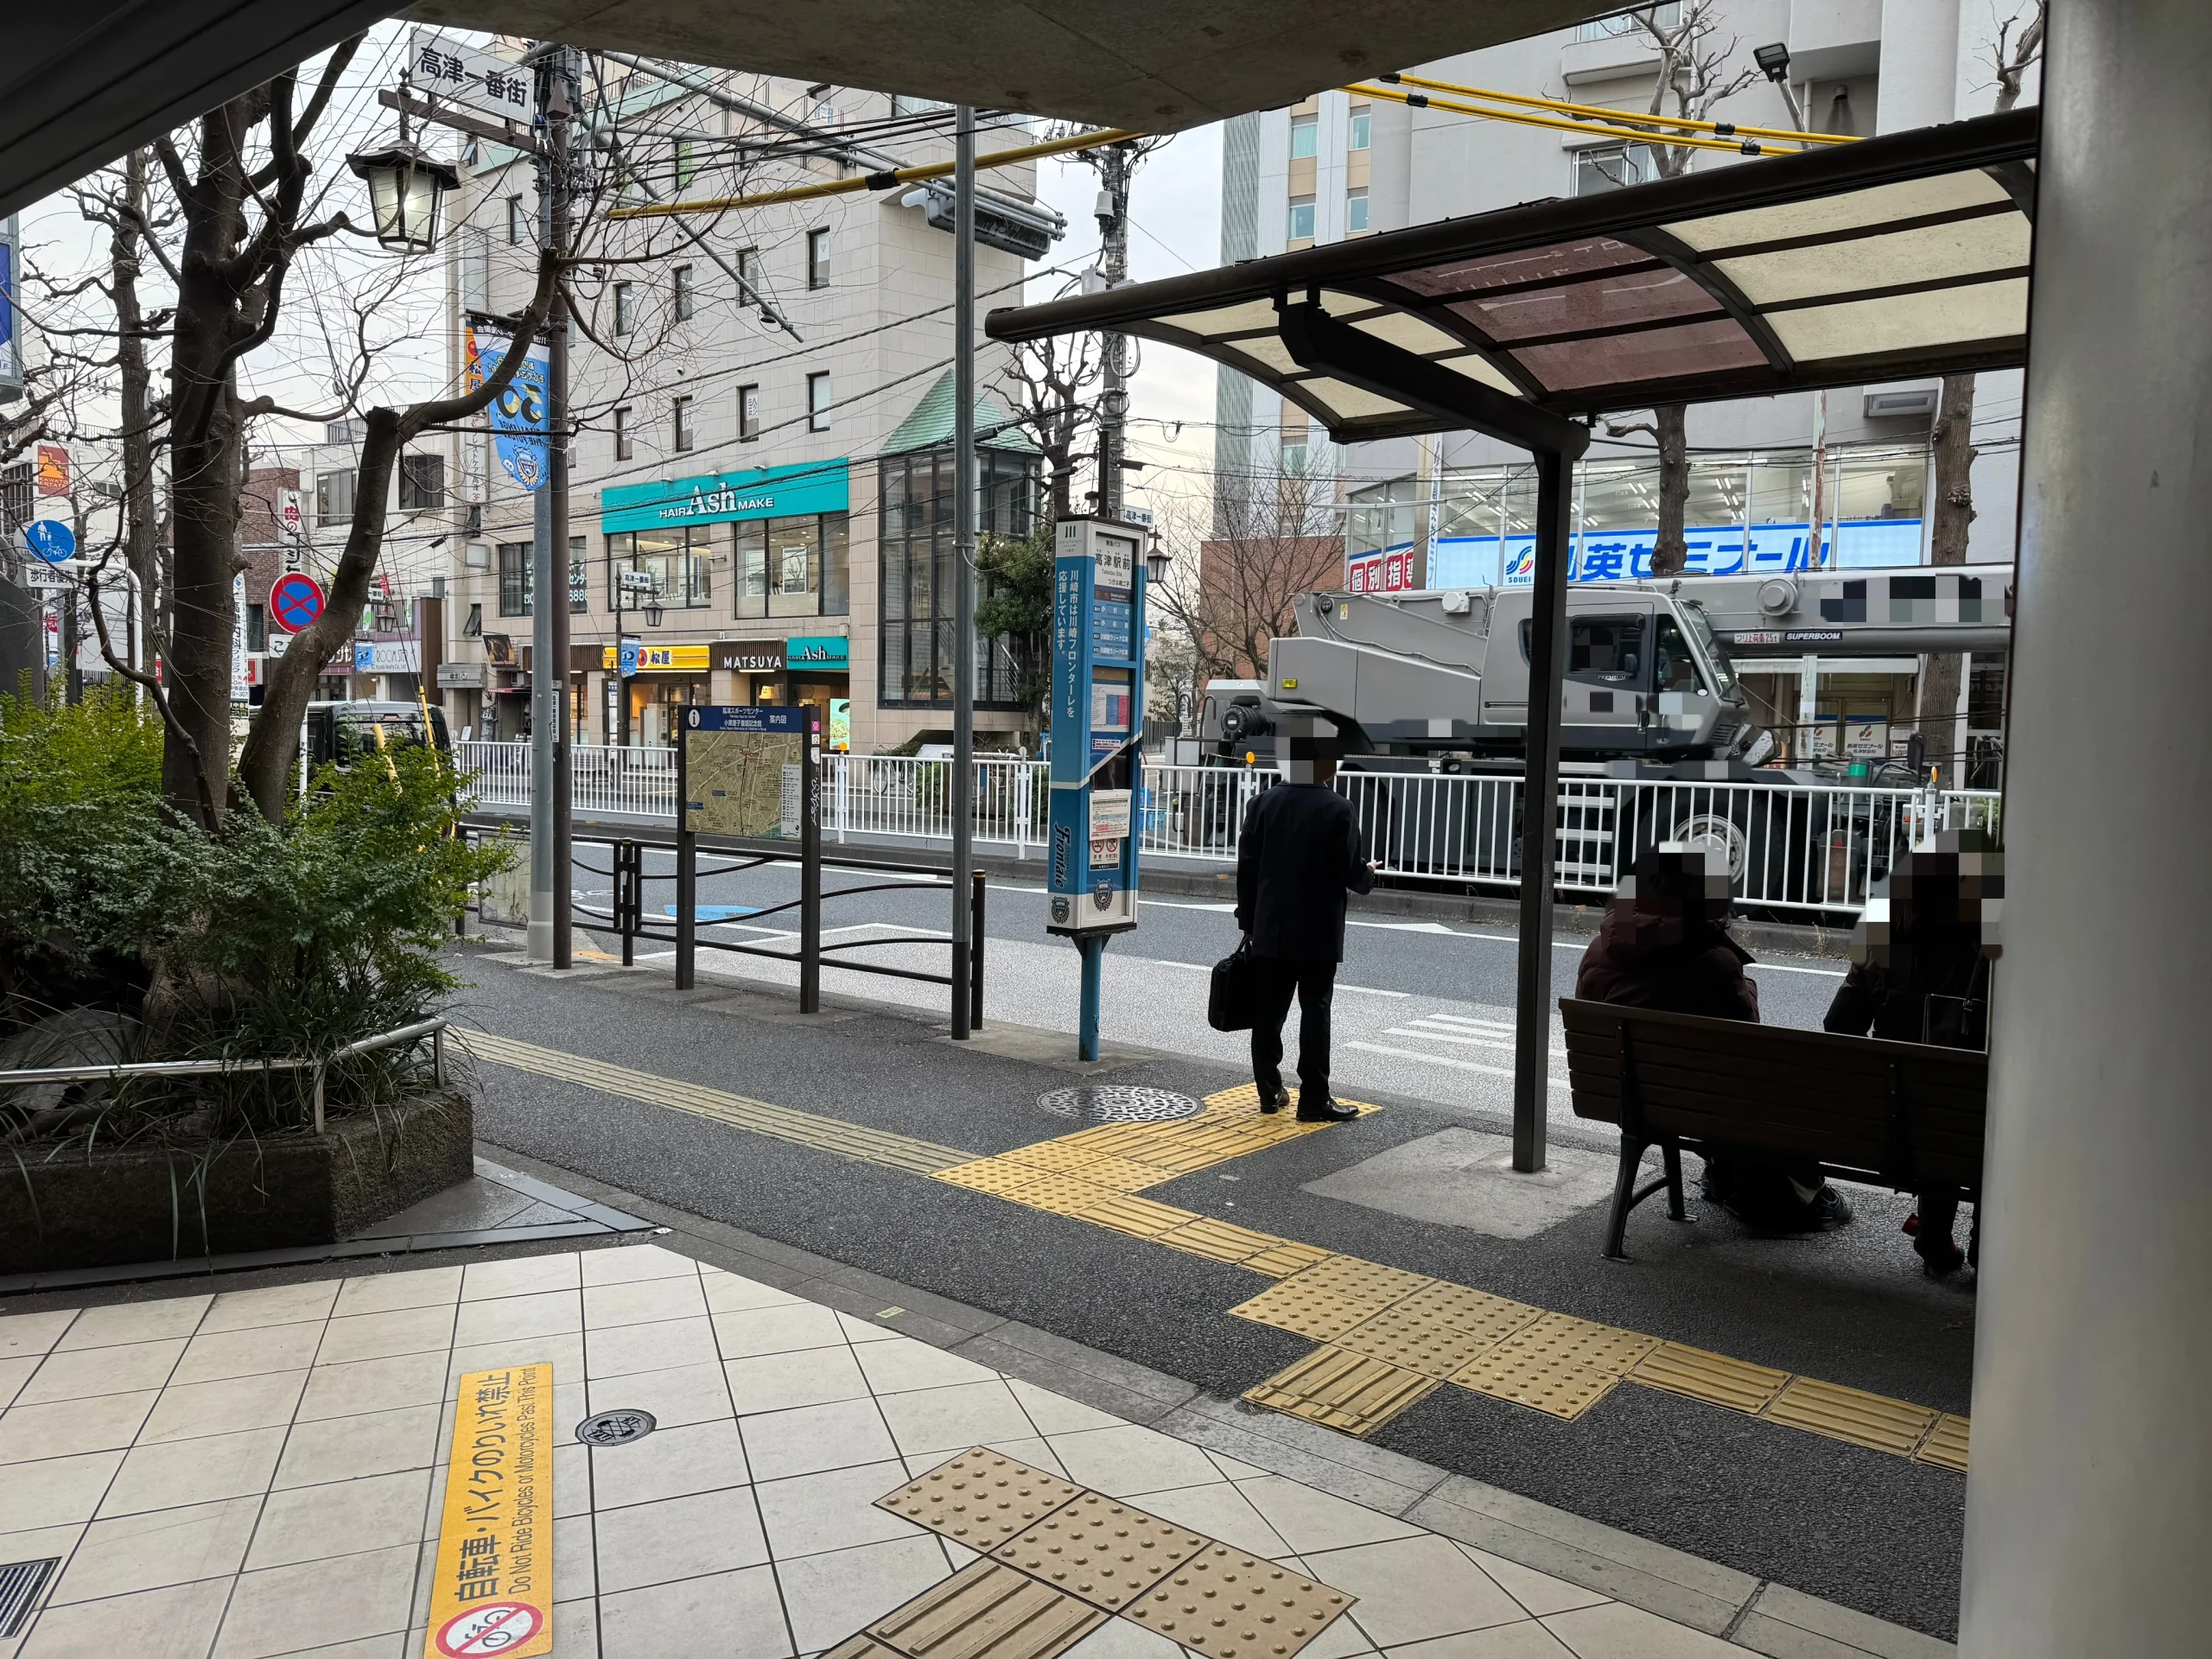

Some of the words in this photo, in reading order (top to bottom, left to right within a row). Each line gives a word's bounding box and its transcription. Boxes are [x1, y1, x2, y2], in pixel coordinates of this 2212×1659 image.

[421, 47, 527, 107] 高津一番街
[39, 476, 68, 485] KAWATO
[659, 506, 686, 518] HAIR
[686, 482, 737, 516] Ash
[738, 497, 774, 510] MAKE
[1095, 553, 1131, 570] 高津駅前
[30, 568, 73, 583] 歩行者優先
[1057, 569, 1068, 655] 応援しています。
[1067, 569, 1079, 718] 川崎市は川崎フロンターレを
[1786, 632, 1841, 640] SUPERBOOM
[651, 650, 671, 664] 松屋
[723, 655, 782, 669] MATSUYA
[800, 645, 828, 661] Ash
[769, 715, 787, 724] 案内図
[1054, 821, 1071, 888] Frontale
[518, 1367, 537, 1386] Point
[518, 1386, 536, 1402] This
[517, 1402, 536, 1421] Past
[514, 1421, 539, 1473] Motorcycles
[454, 1371, 511, 1602] 自転車・バイクのりいれ禁止
[520, 1474, 534, 1484] or
[512, 1485, 539, 1527] Bicycles
[510, 1528, 533, 1554] Ride
[509, 1555, 532, 1575] Not
[508, 1575, 531, 1595] Do
